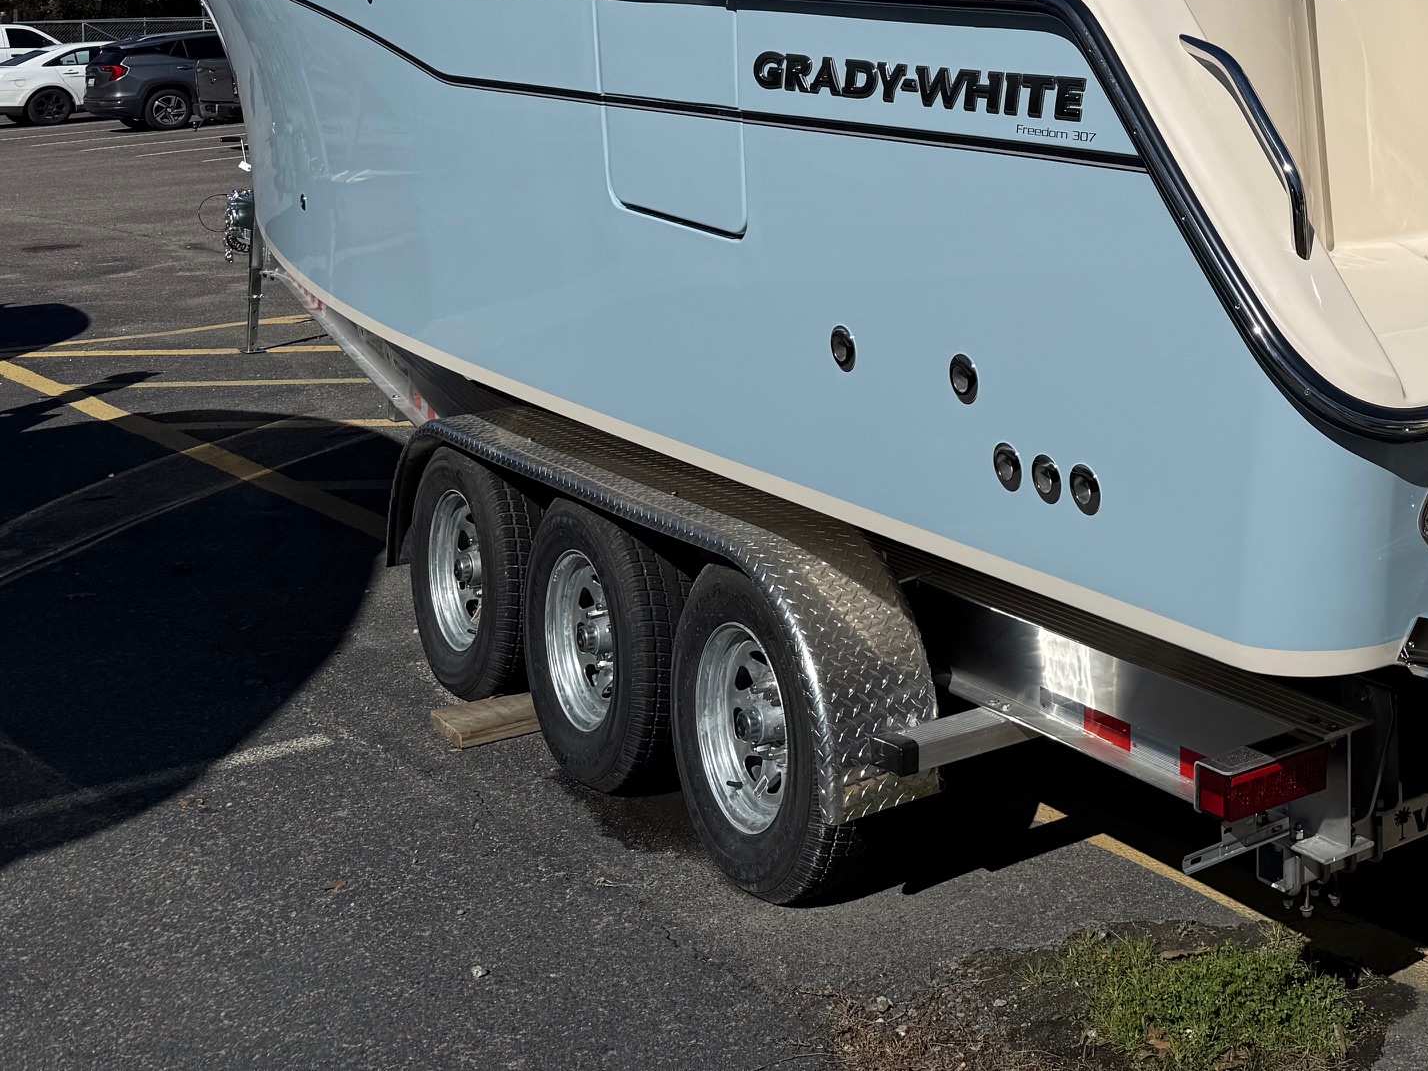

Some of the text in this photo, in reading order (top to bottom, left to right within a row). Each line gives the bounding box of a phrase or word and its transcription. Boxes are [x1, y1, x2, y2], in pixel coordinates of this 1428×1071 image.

[753, 51, 1088, 123] GRADY-WHITE
[1016, 123, 1097, 143] Freedom 307
